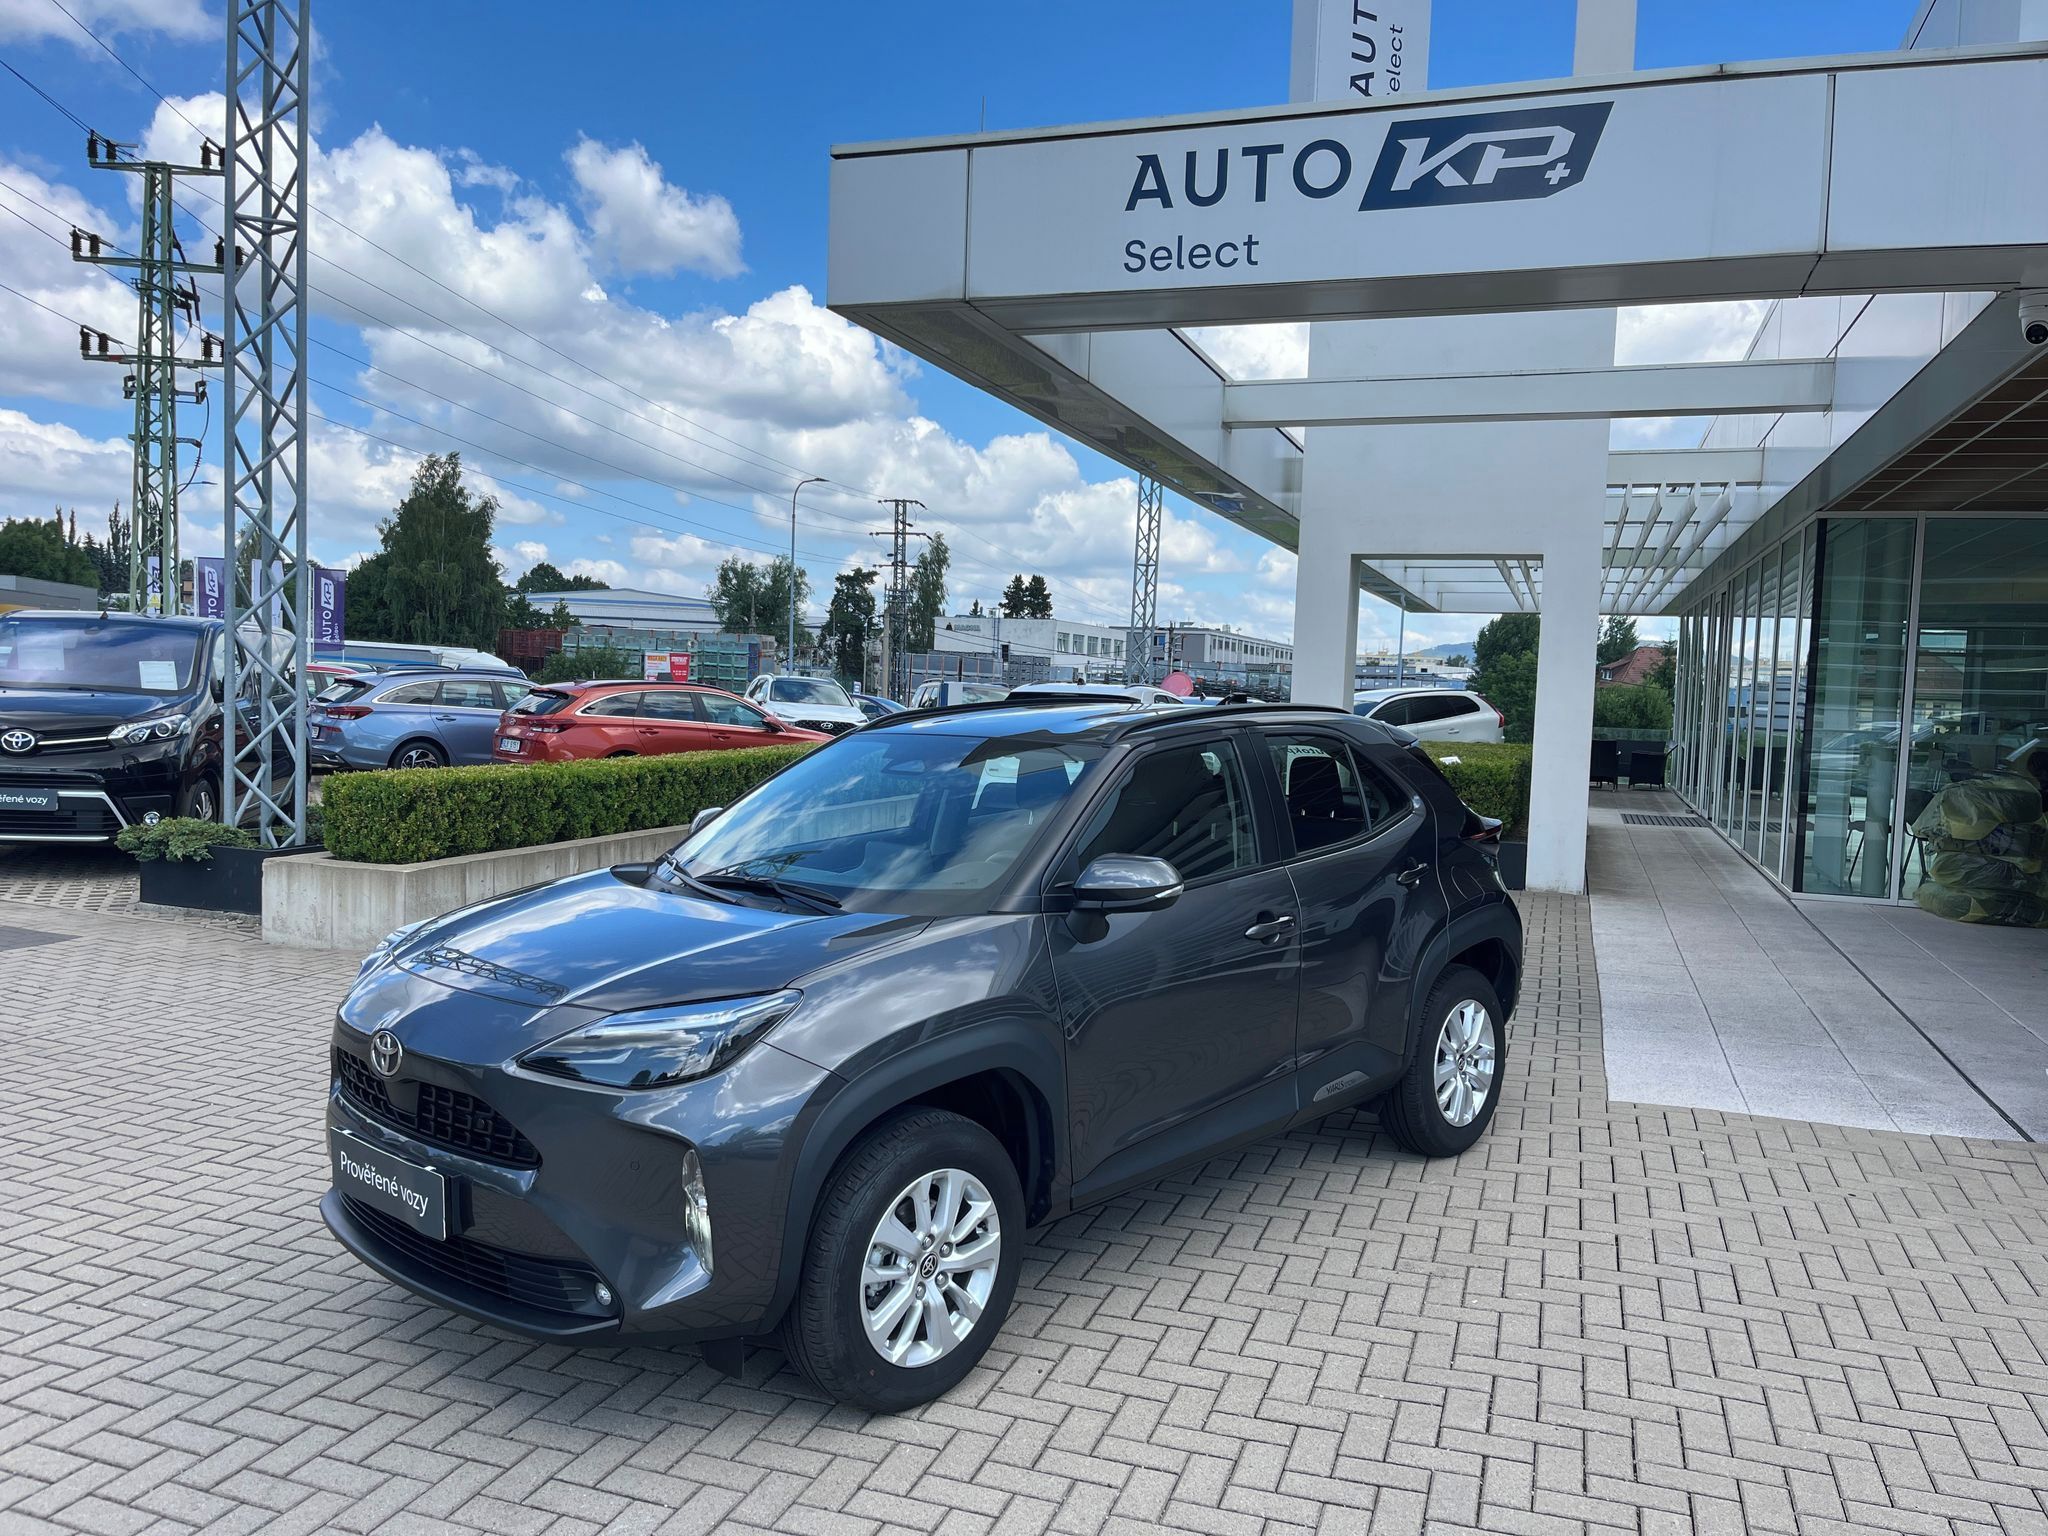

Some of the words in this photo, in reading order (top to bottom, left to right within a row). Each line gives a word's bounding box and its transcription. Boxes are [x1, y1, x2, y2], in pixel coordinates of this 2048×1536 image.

[1386, 24, 1403, 95] elect
[1125, 139, 1351, 211] AUTO
[1123, 234, 1259, 273] Select
[322, 610, 332, 643] AUTO
[26, 796, 48, 806] vozy
[340, 1150, 398, 1197] Prověřené
[400, 1185, 429, 1217] vozy
